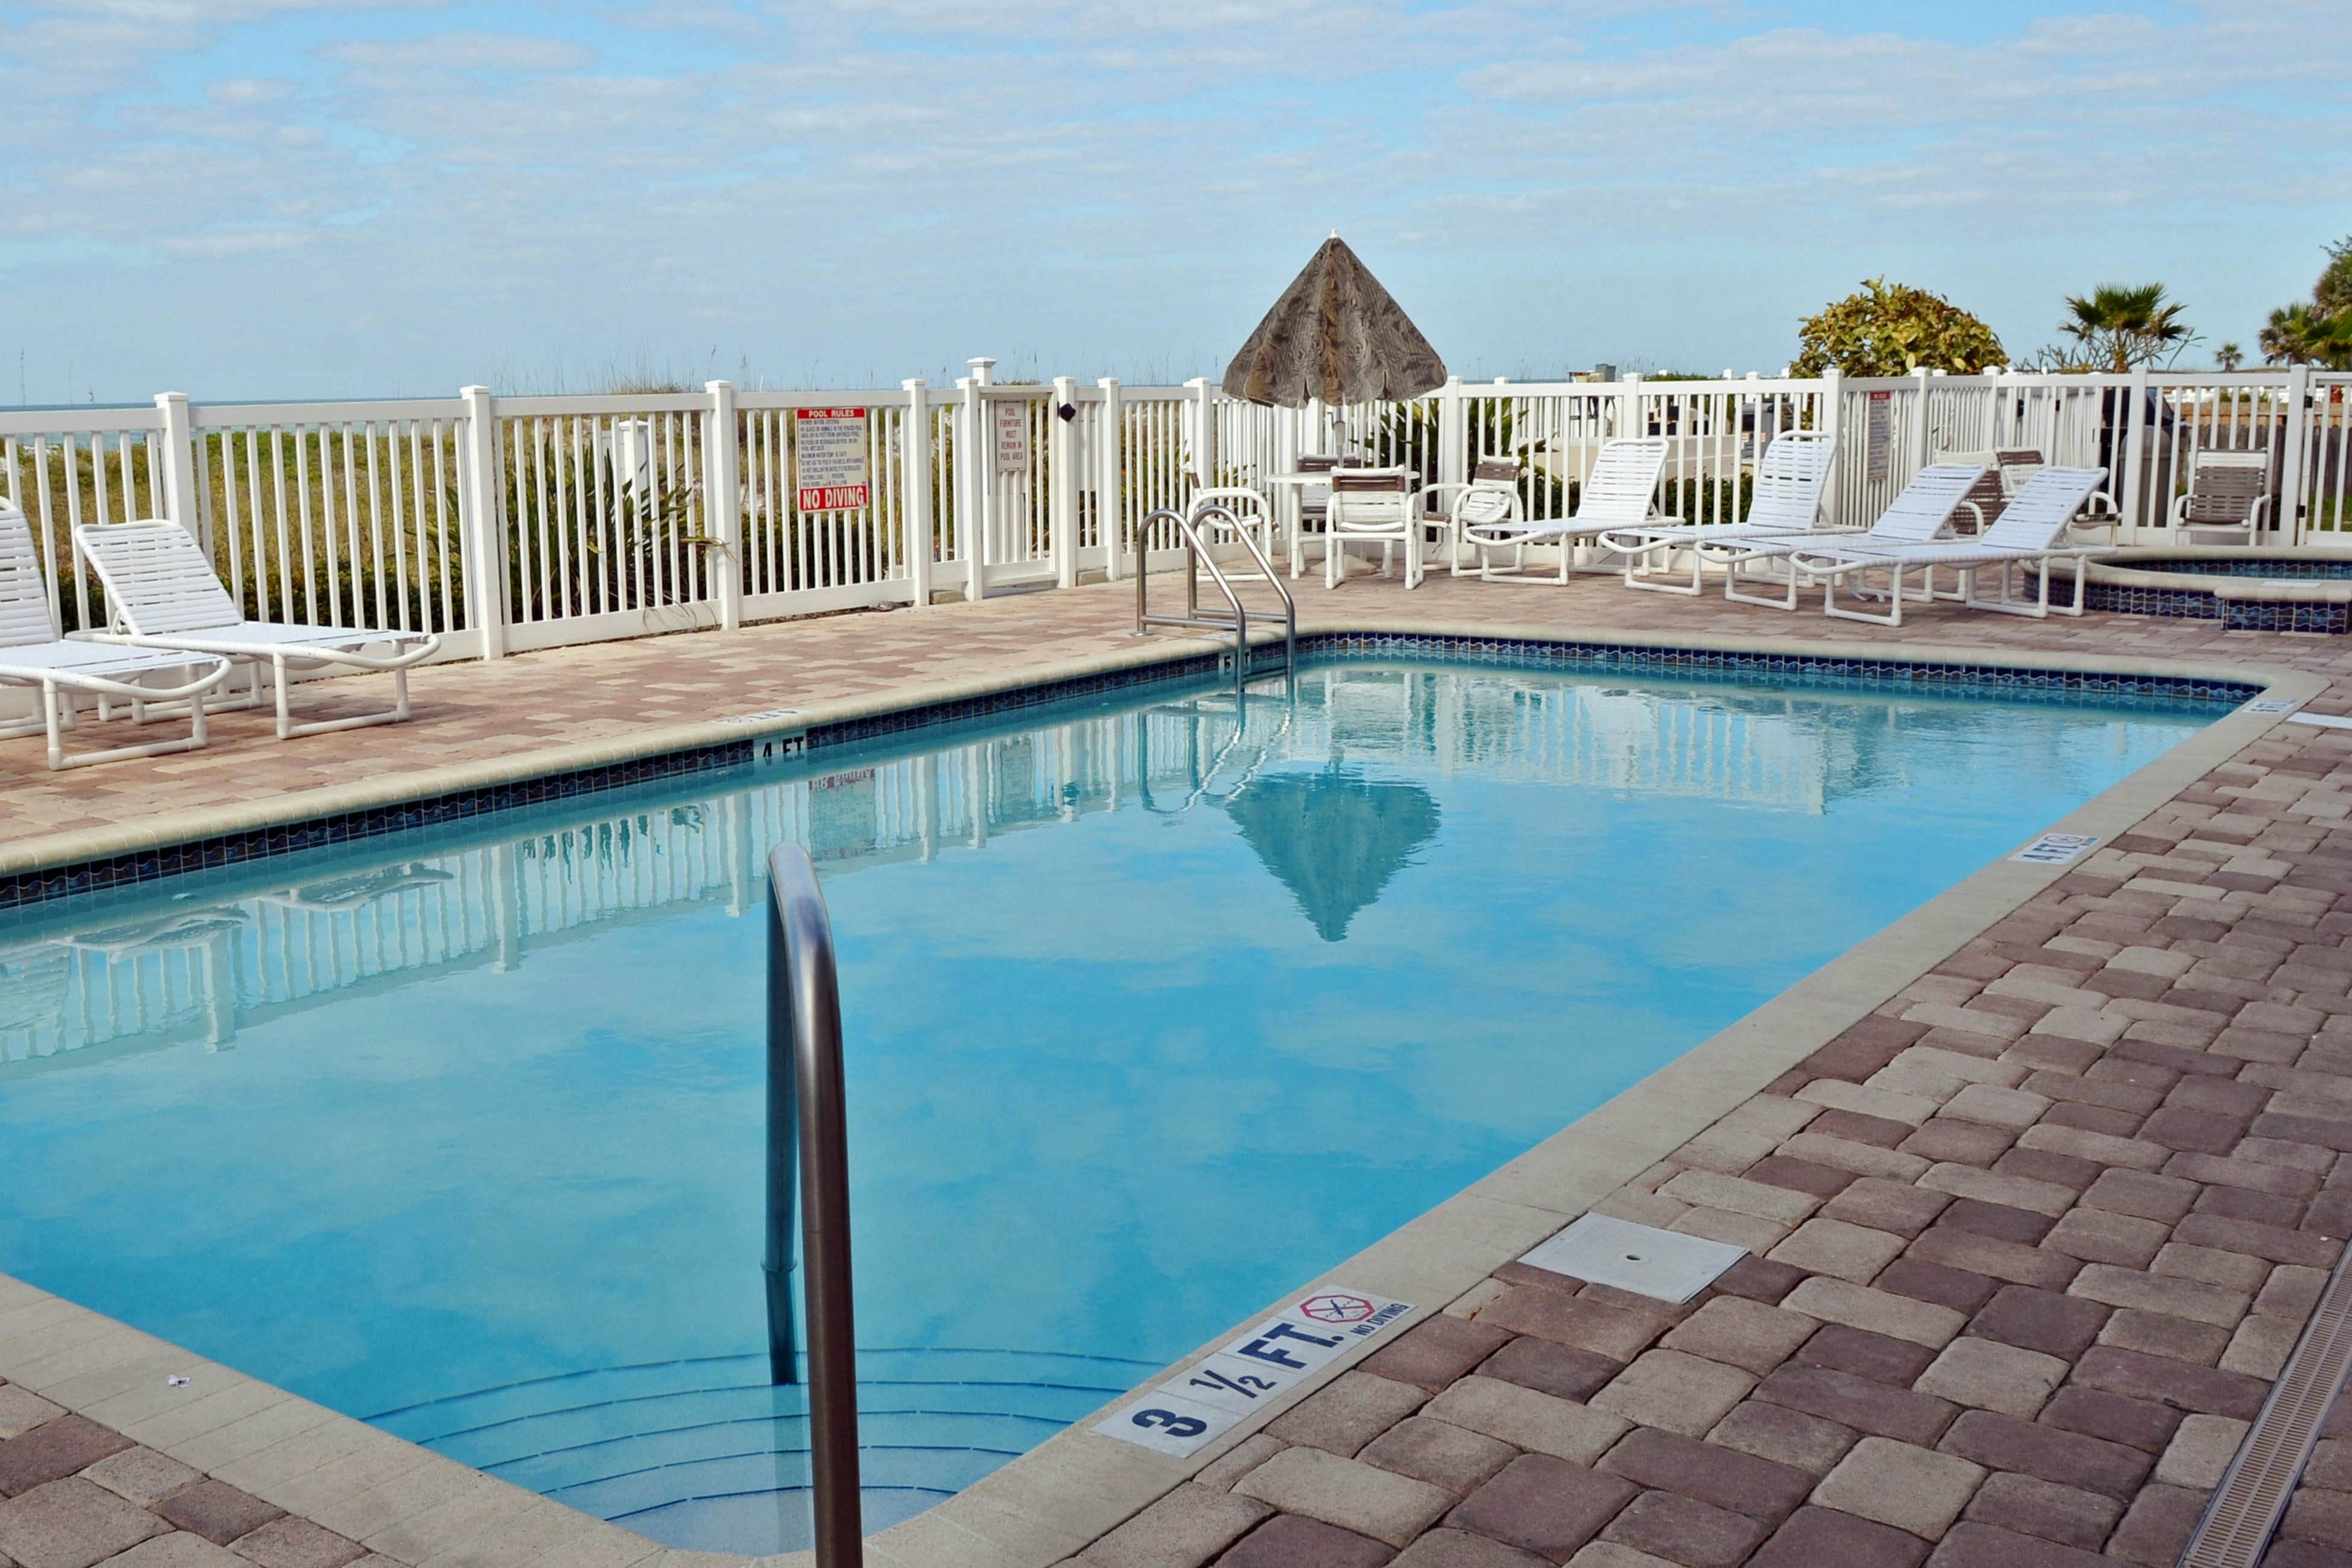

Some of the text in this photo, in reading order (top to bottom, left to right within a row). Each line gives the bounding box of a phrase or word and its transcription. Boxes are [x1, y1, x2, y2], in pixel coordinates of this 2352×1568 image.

[803, 486, 864, 509] NO DIVING
[783, 736, 805, 754] FT
[1350, 1303, 1409, 1336] NO DIVING
[1132, 1408, 1207, 1438] 3
[1238, 1323, 1345, 1370] FT.
